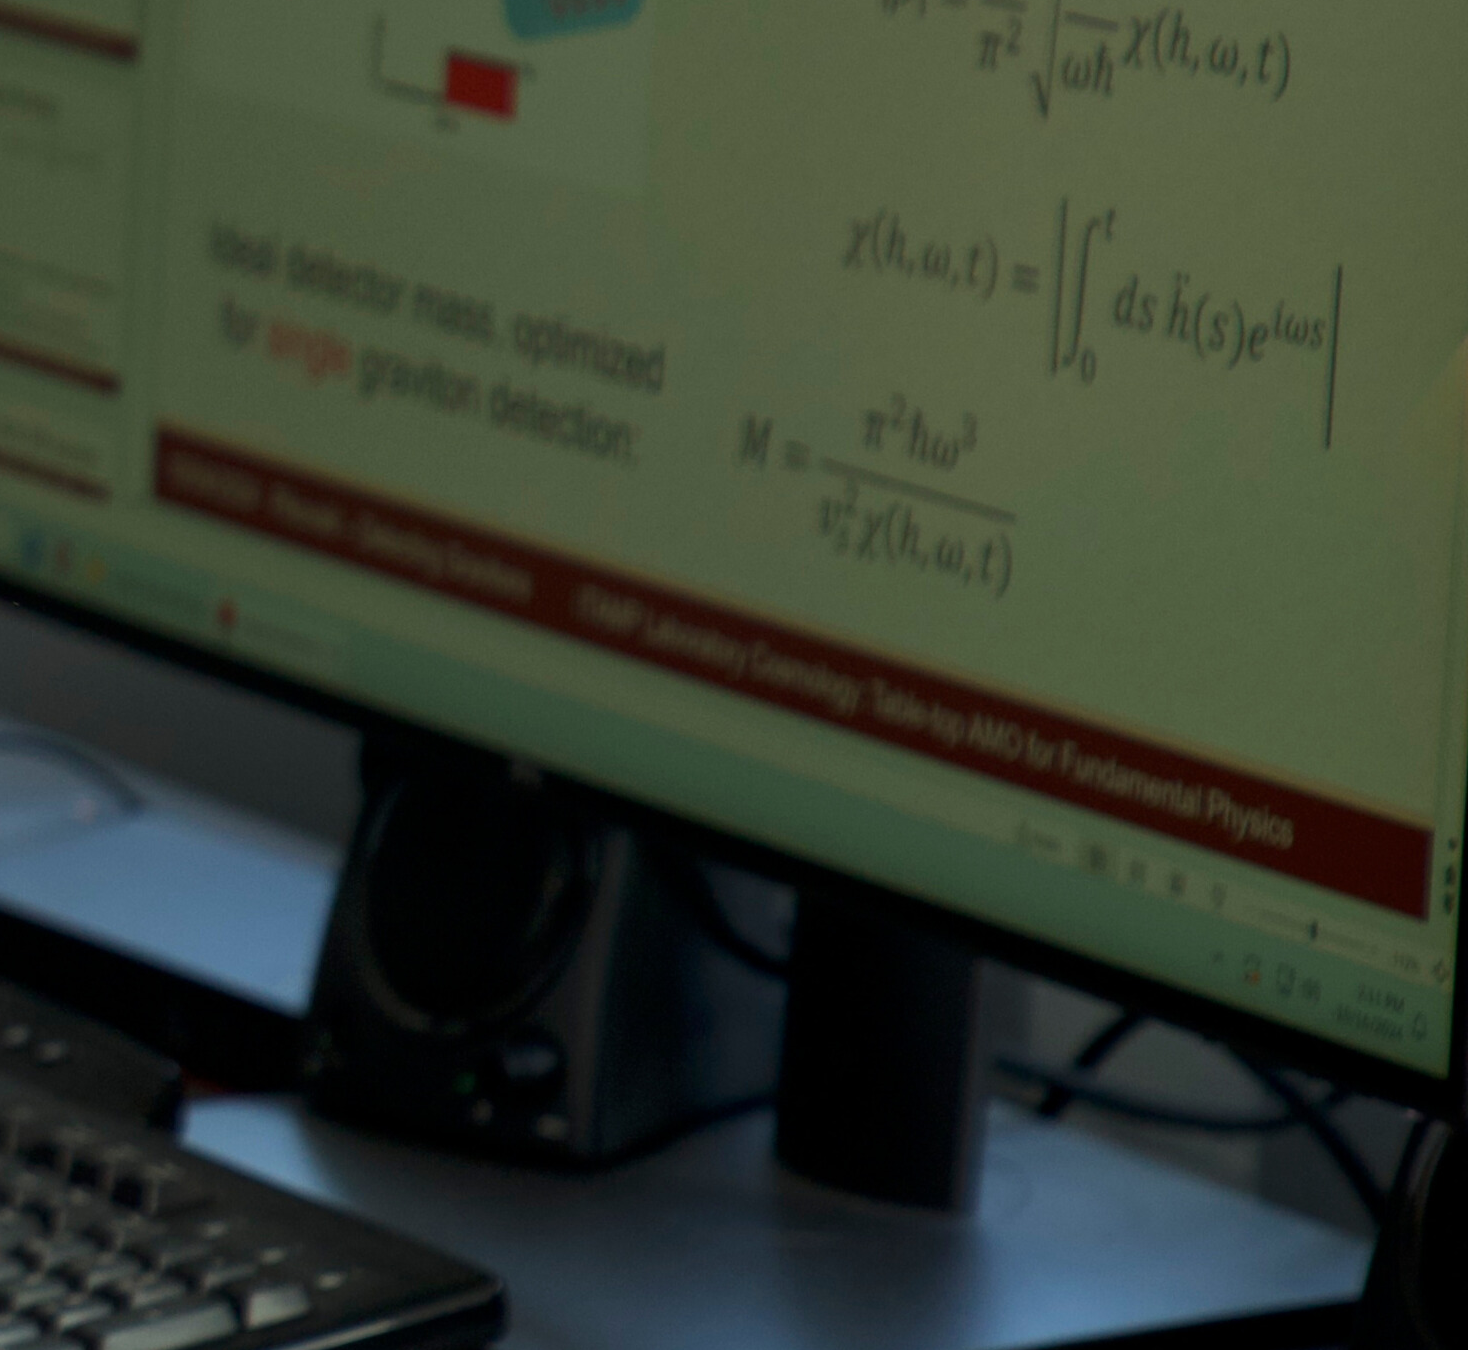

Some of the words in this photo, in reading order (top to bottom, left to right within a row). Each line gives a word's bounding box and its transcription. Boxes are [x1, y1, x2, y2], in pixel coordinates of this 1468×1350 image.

[286, 239, 404, 317] detector
[513, 311, 666, 396] optimized
[358, 343, 483, 415] graviton
[969, 711, 1023, 763] AMO
[1028, 729, 1060, 771] for
[1061, 740, 1204, 820] Fundamental
[1207, 786, 1295, 850] Physics
